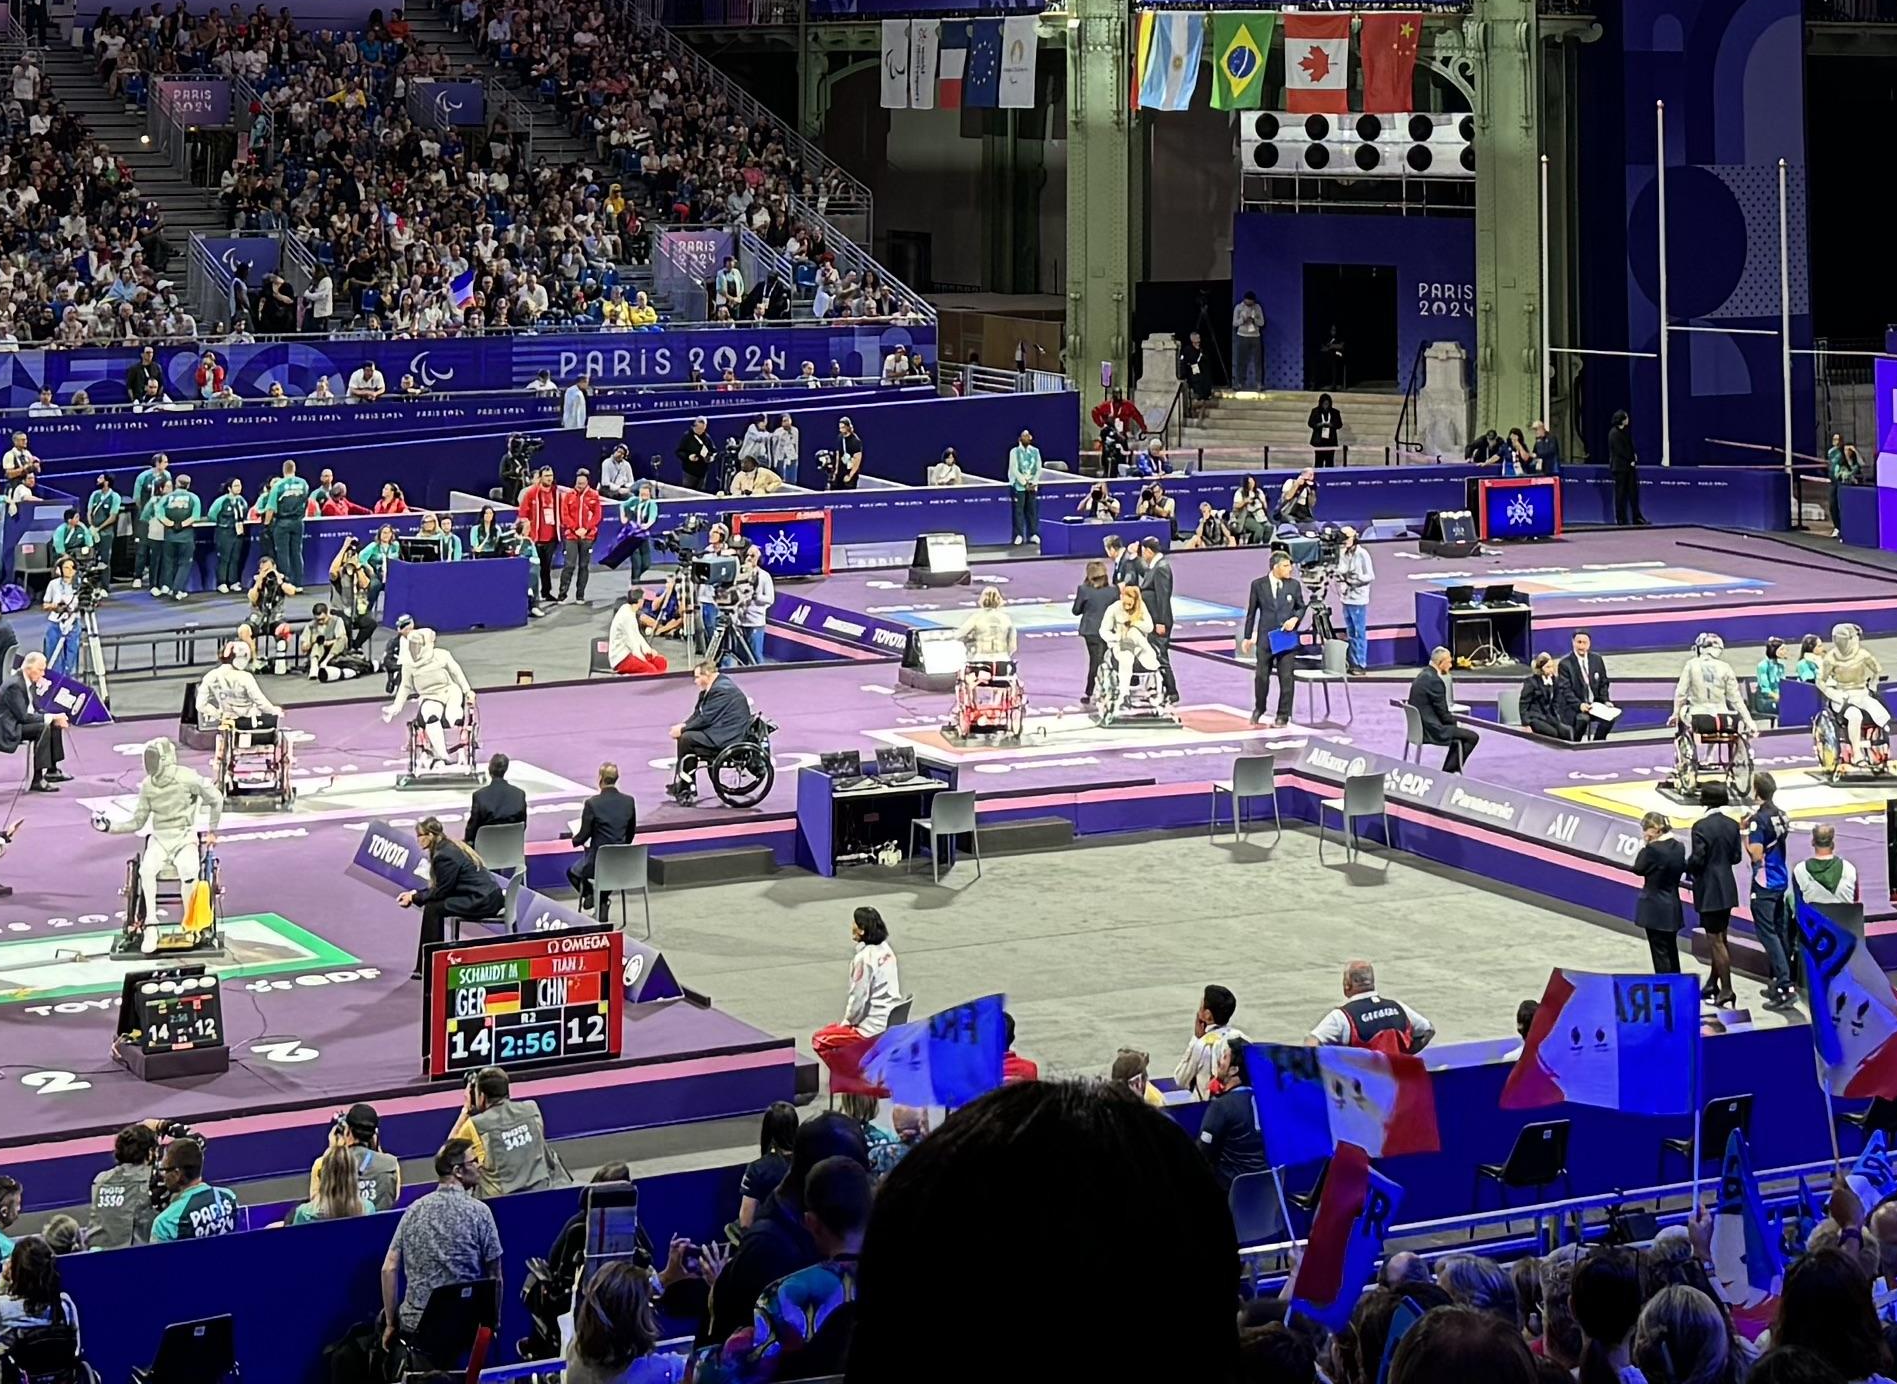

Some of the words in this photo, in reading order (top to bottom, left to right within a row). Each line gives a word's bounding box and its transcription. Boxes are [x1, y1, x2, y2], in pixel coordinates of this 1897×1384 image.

[173, 89, 212, 100] PARIS
[173, 101, 212, 112] 2024
[678, 240, 716, 252] PARIS
[1418, 283, 1473, 300] PARIS
[1419, 300, 1474, 317] 2024
[560, 348, 671, 378] PARIS
[688, 344, 786, 373] 2024
[1306, 747, 1349, 775] Allianz
[1450, 787, 1516, 820] Panasonic
[1548, 814, 1580, 842] All
[368, 833, 410, 869] TOYOTA
[561, 935, 611, 953] OMEGA
[552, 958, 577, 973] TIAN
[455, 987, 486, 1017] GER
[537, 976, 567, 1008] CHN
[149, 1023, 169, 1042] 14
[195, 1018, 216, 1036] 12
[566, 1015, 605, 1045] 12
[450, 1028, 491, 1059] 14
[500, 1030, 557, 1058] 2:56
[20, 1071, 92, 1094] 2
[504, 1130, 533, 1152] 3424
[97, 1194, 125, 1208] 3550
